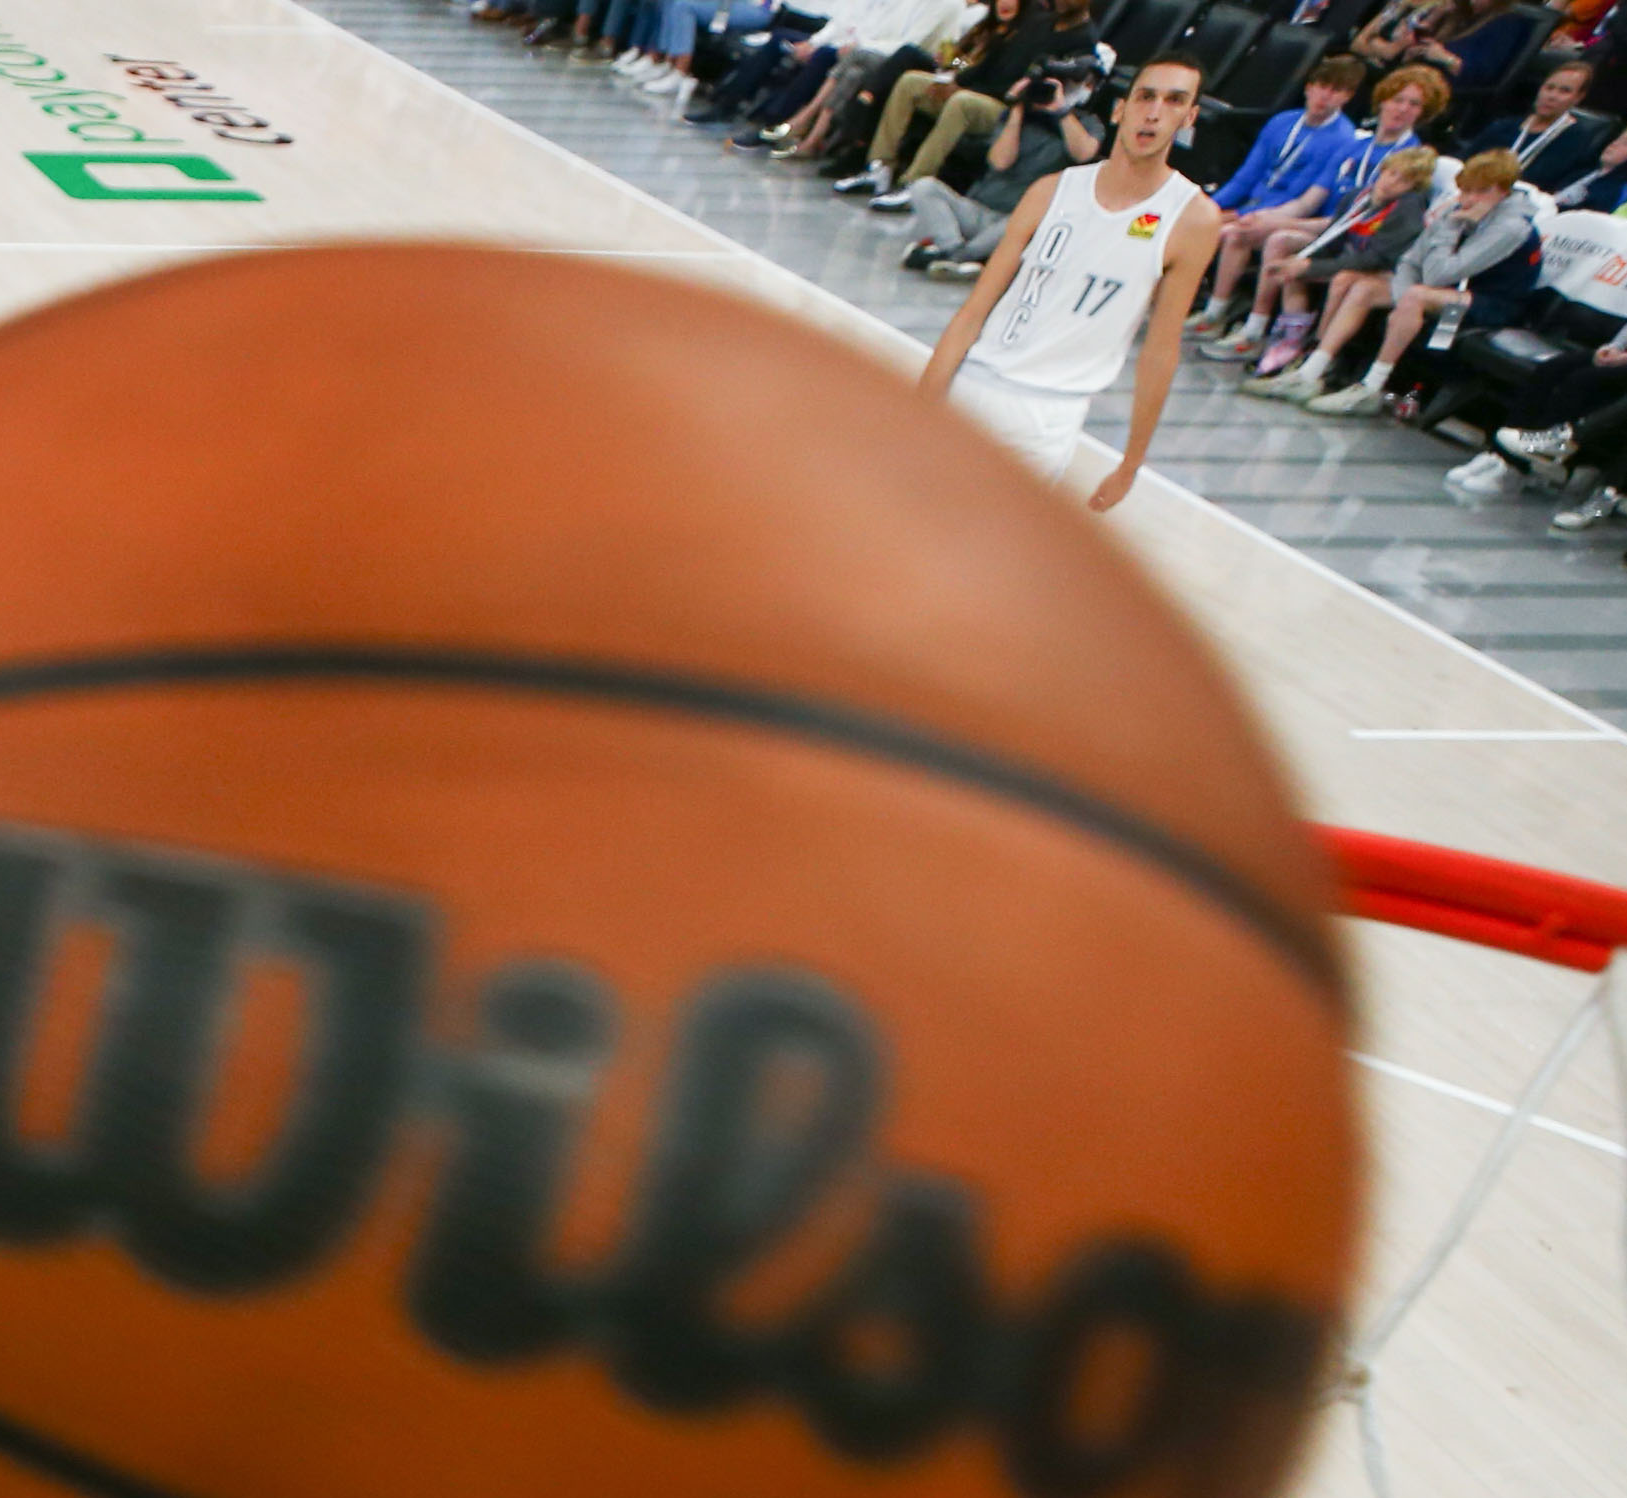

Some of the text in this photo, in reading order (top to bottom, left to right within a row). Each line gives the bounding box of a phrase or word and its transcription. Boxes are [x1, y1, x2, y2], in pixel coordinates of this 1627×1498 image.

[105, 52, 295, 146] center
[1002, 222, 1072, 347] OKC
[1073, 273, 1124, 317] 17
